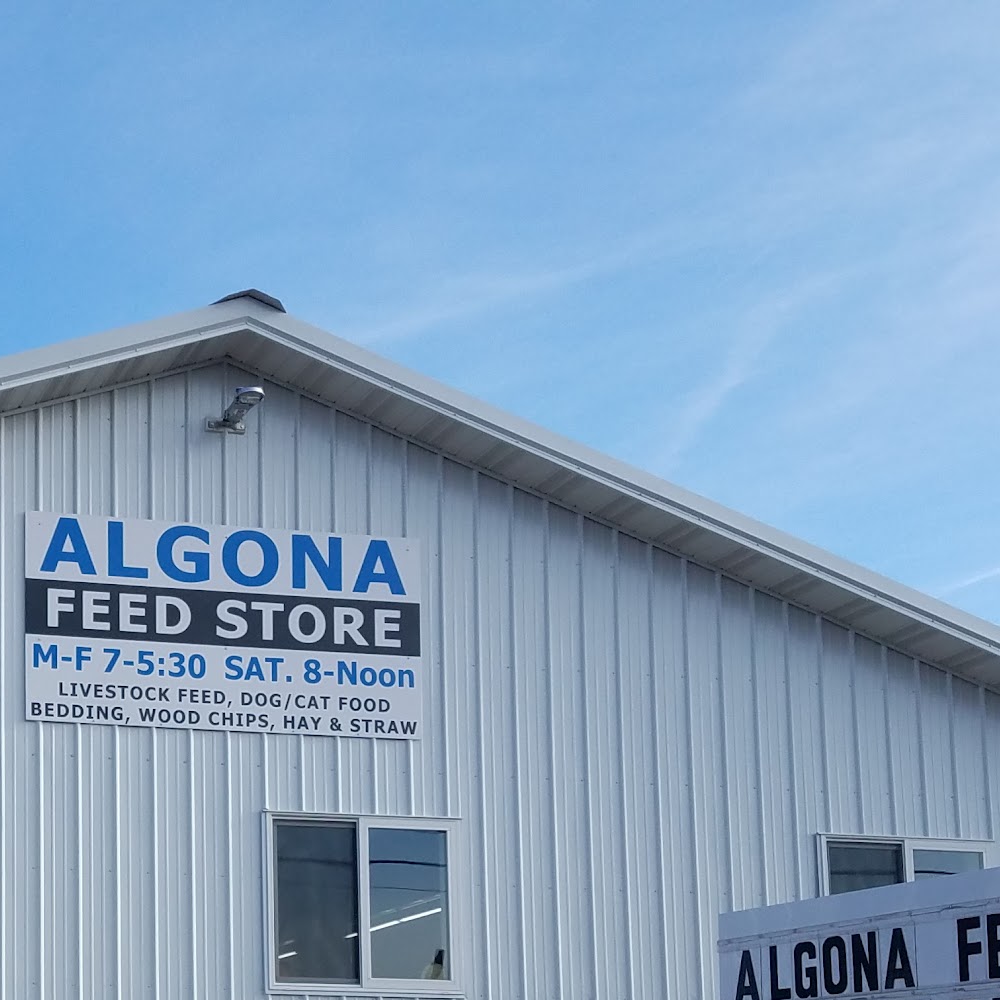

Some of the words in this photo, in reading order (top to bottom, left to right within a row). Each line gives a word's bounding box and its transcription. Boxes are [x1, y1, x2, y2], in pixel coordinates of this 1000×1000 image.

[40, 517, 406, 596] ALGONA
[46, 587, 192, 635] FEED
[216, 599, 402, 647] STORE
[33, 643, 92, 671] M-F
[103, 648, 206, 679] 7-5:30
[224, 655, 291, 682] SAT.
[304, 660, 414, 688] 8-Noon
[31, 703, 130, 723] BEDDING,
[139, 708, 200, 725] WOOD
[209, 712, 275, 730] CHIPS,
[283, 716, 322, 730] HAY
[329, 718, 343, 731] &
[350, 719, 417, 735] STRAW
[59, 682, 169, 702] LIVESTOCK
[178, 688, 232, 707] FEED,
[241, 692, 330, 710] DOG/CAT
[339, 697, 390, 713] FOOD
